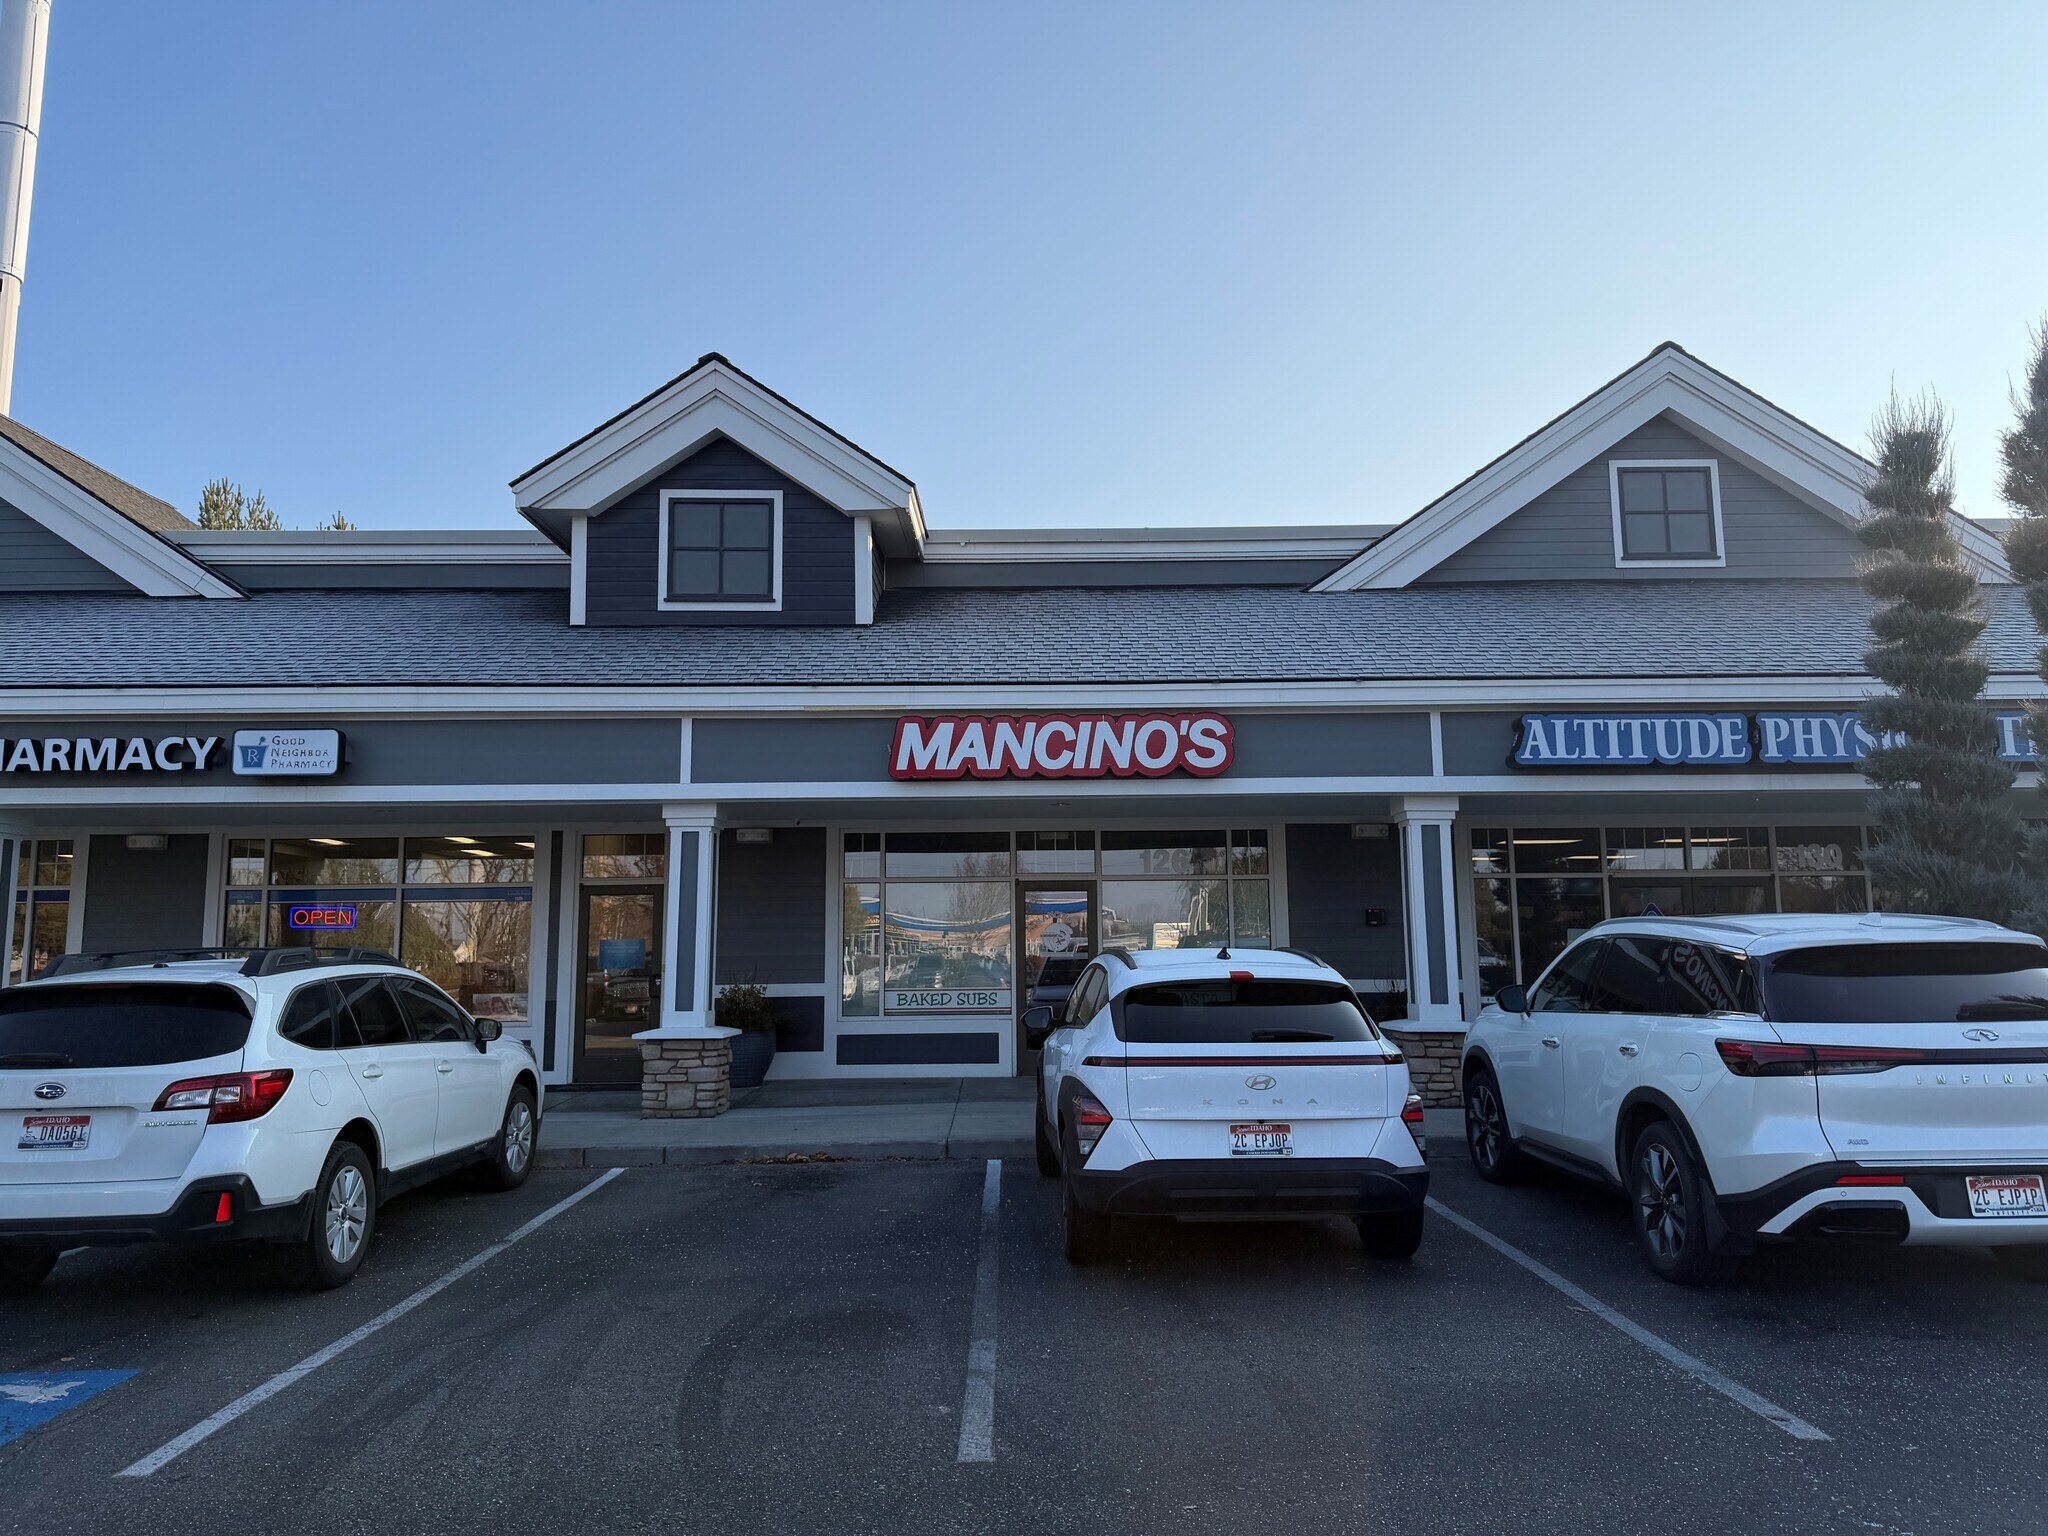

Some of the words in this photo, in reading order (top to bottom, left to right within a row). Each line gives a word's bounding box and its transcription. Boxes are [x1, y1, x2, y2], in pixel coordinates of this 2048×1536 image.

[896, 718, 1228, 771] MANCINO'S
[1520, 718, 1746, 759] ALTITUDE
[0, 737, 219, 772] ARMACY
[1139, 848, 1191, 874] 126
[1797, 843, 1843, 870] 130
[293, 909, 353, 926] OPEN
[896, 992, 952, 1007] BAKED
[956, 991, 998, 1006] SUBS
[1202, 1098, 1319, 1106] KONA
[45, 1116, 71, 1124] IDAHO
[1249, 1124, 1273, 1132] IDAHO
[1233, 1133, 1248, 1148] 2C
[1991, 1179, 2018, 1187] IDAHO
[1973, 1188, 1991, 1206] 2C
[1997, 1188, 2038, 1206] EJP1P
